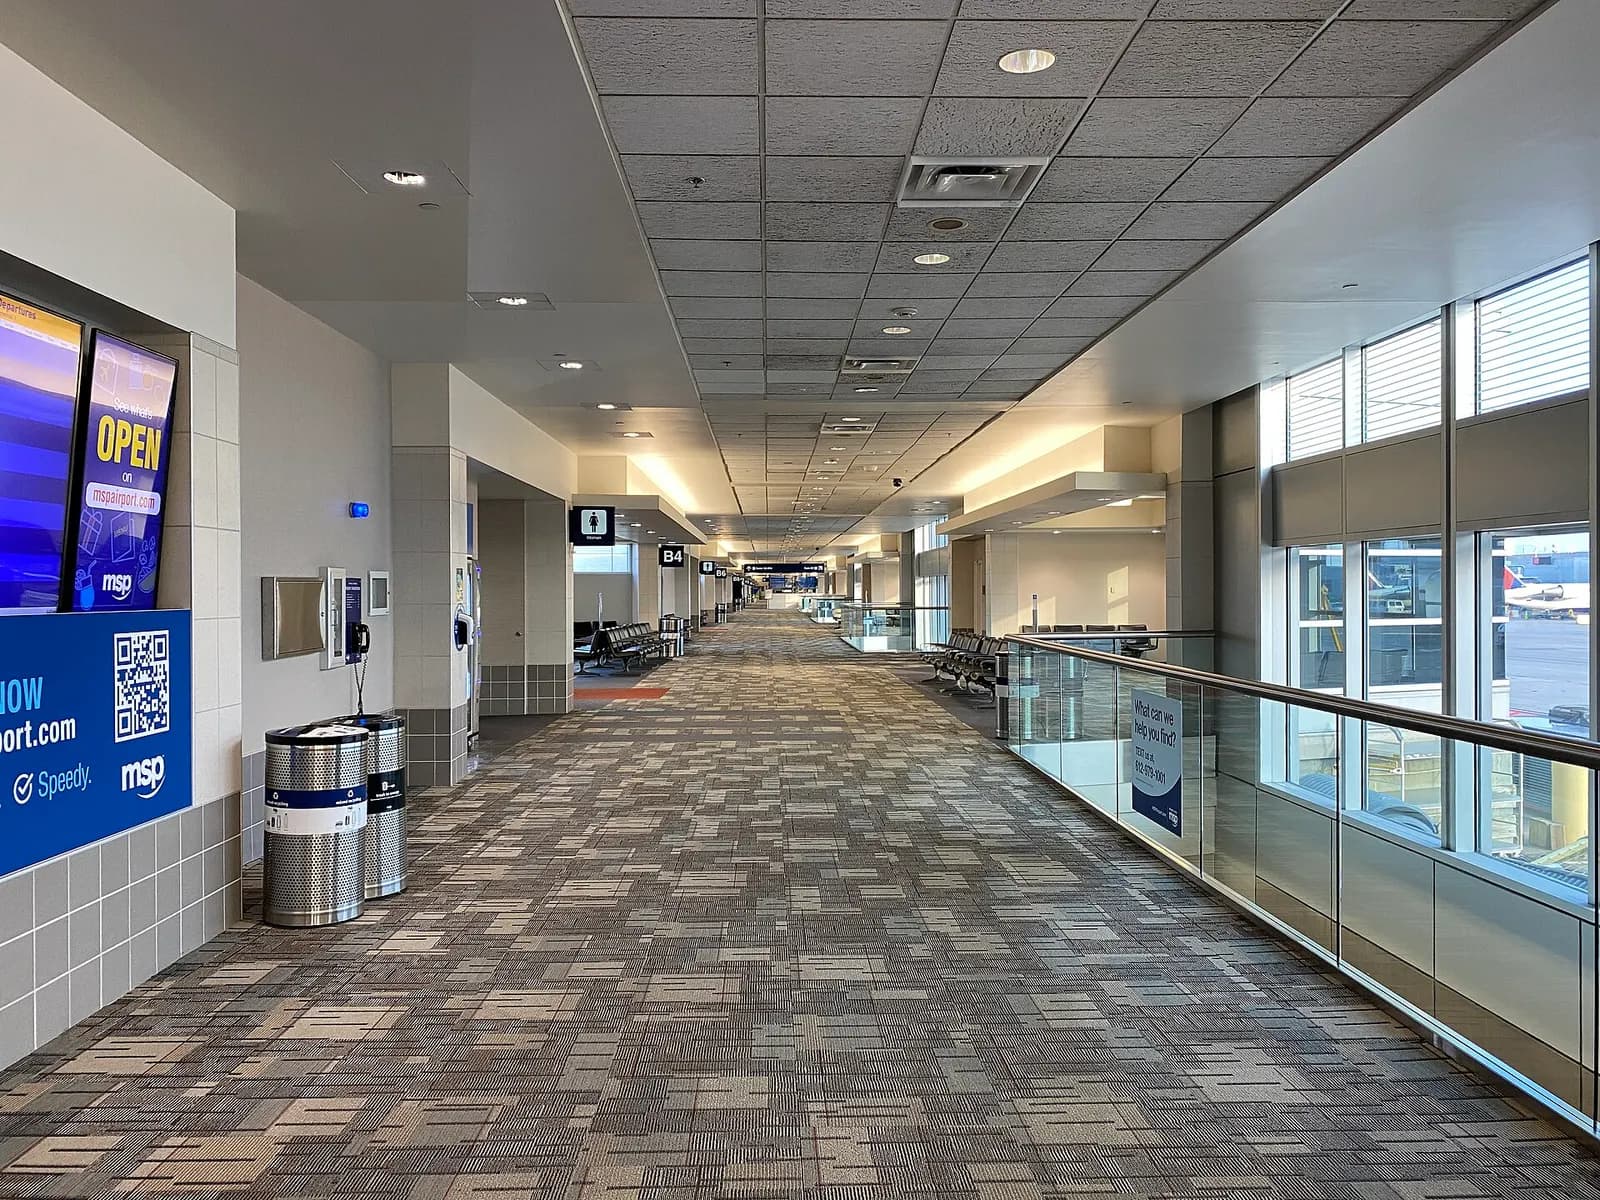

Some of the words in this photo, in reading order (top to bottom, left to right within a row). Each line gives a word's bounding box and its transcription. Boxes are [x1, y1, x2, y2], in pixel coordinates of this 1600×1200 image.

[113, 397, 129, 413] See
[97, 414, 161, 471] OPEN
[122, 472, 132, 483] on
[92, 488, 155, 511] mspairport.com
[663, 550, 683, 563] B4
[102, 574, 132, 596] msp
[716, 569, 726, 577] B6
[1135, 698, 1150, 718] What
[1150, 708, 1163, 722] can
[1163, 711, 1174, 726] we
[0, 716, 76, 754] ort.com
[1134, 718, 1148, 740] help
[1148, 726, 1160, 741] you
[1160, 727, 1177, 748] find?
[38, 762, 92, 800] Speedy.
[121, 755, 165, 792] msp
